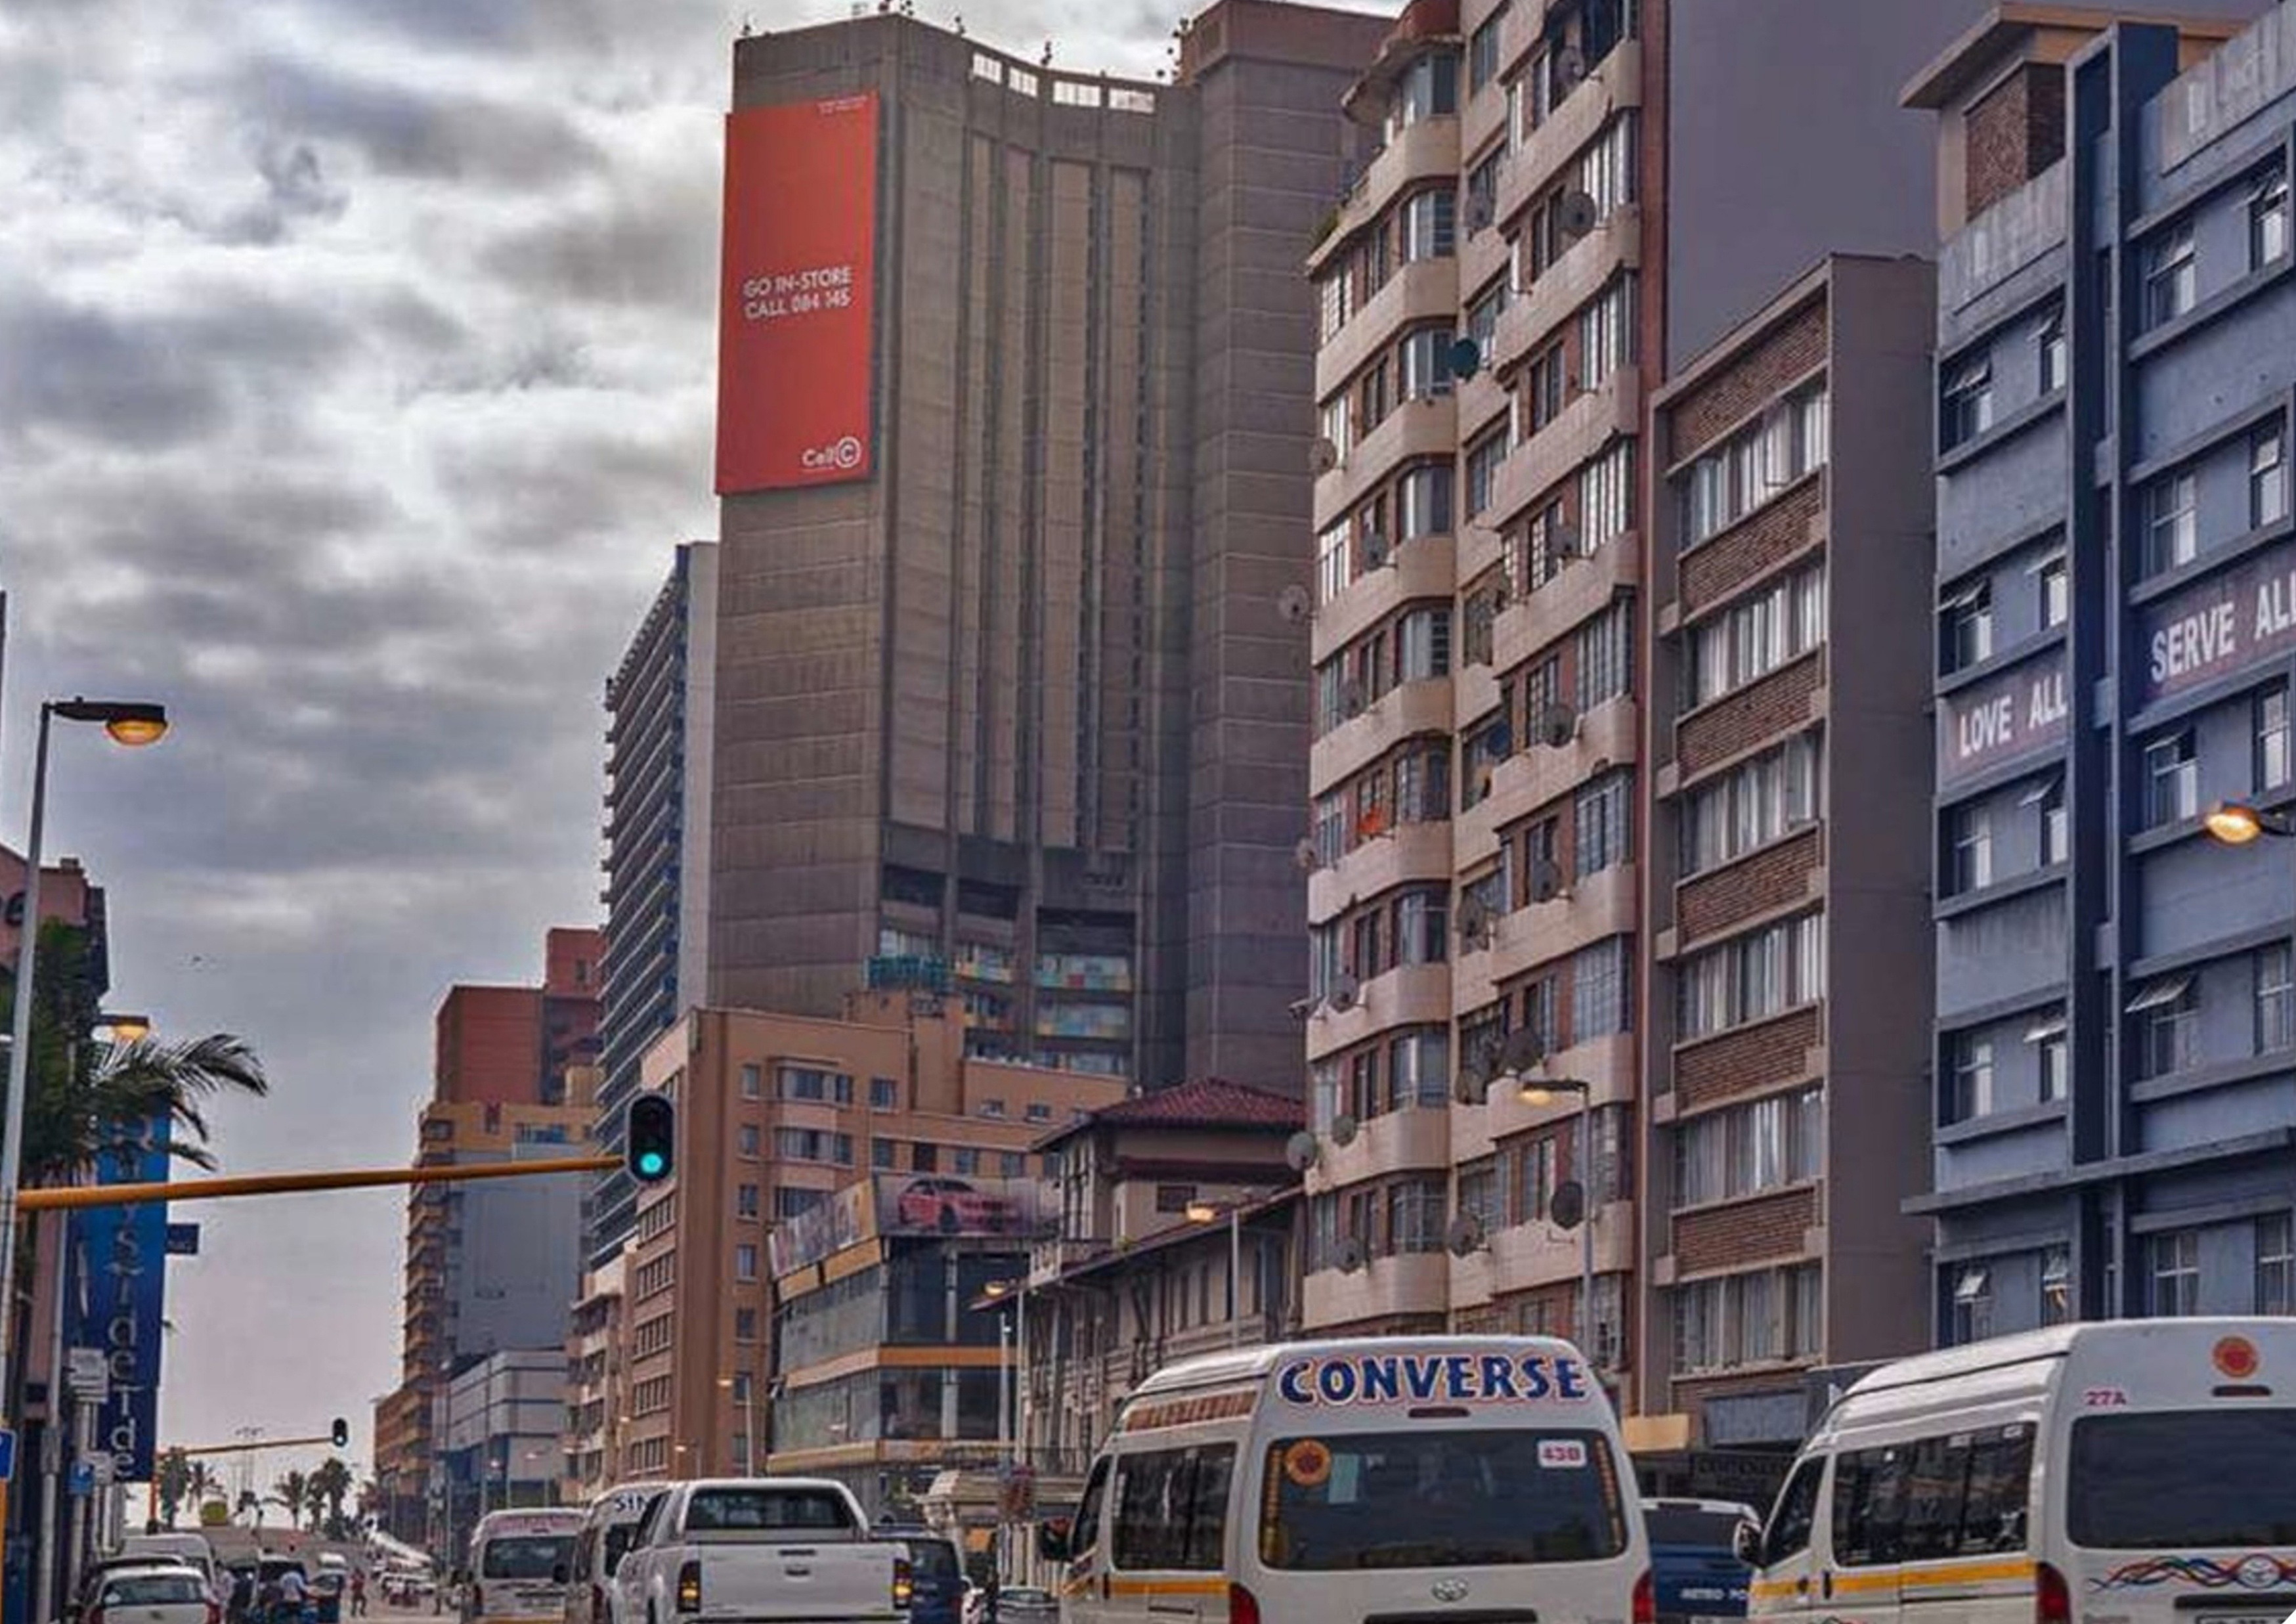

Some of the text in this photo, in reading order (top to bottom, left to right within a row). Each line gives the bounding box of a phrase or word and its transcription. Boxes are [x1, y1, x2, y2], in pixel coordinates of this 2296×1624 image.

[743, 267, 852, 298] GO IN-STORE
[745, 298, 788, 319] CALL
[2151, 602, 2235, 681] SERVE
[1960, 673, 2068, 757] LOVE ALL
[1279, 1353, 1589, 1404] CONVERSE
[2084, 1390, 2127, 1407] 27A
